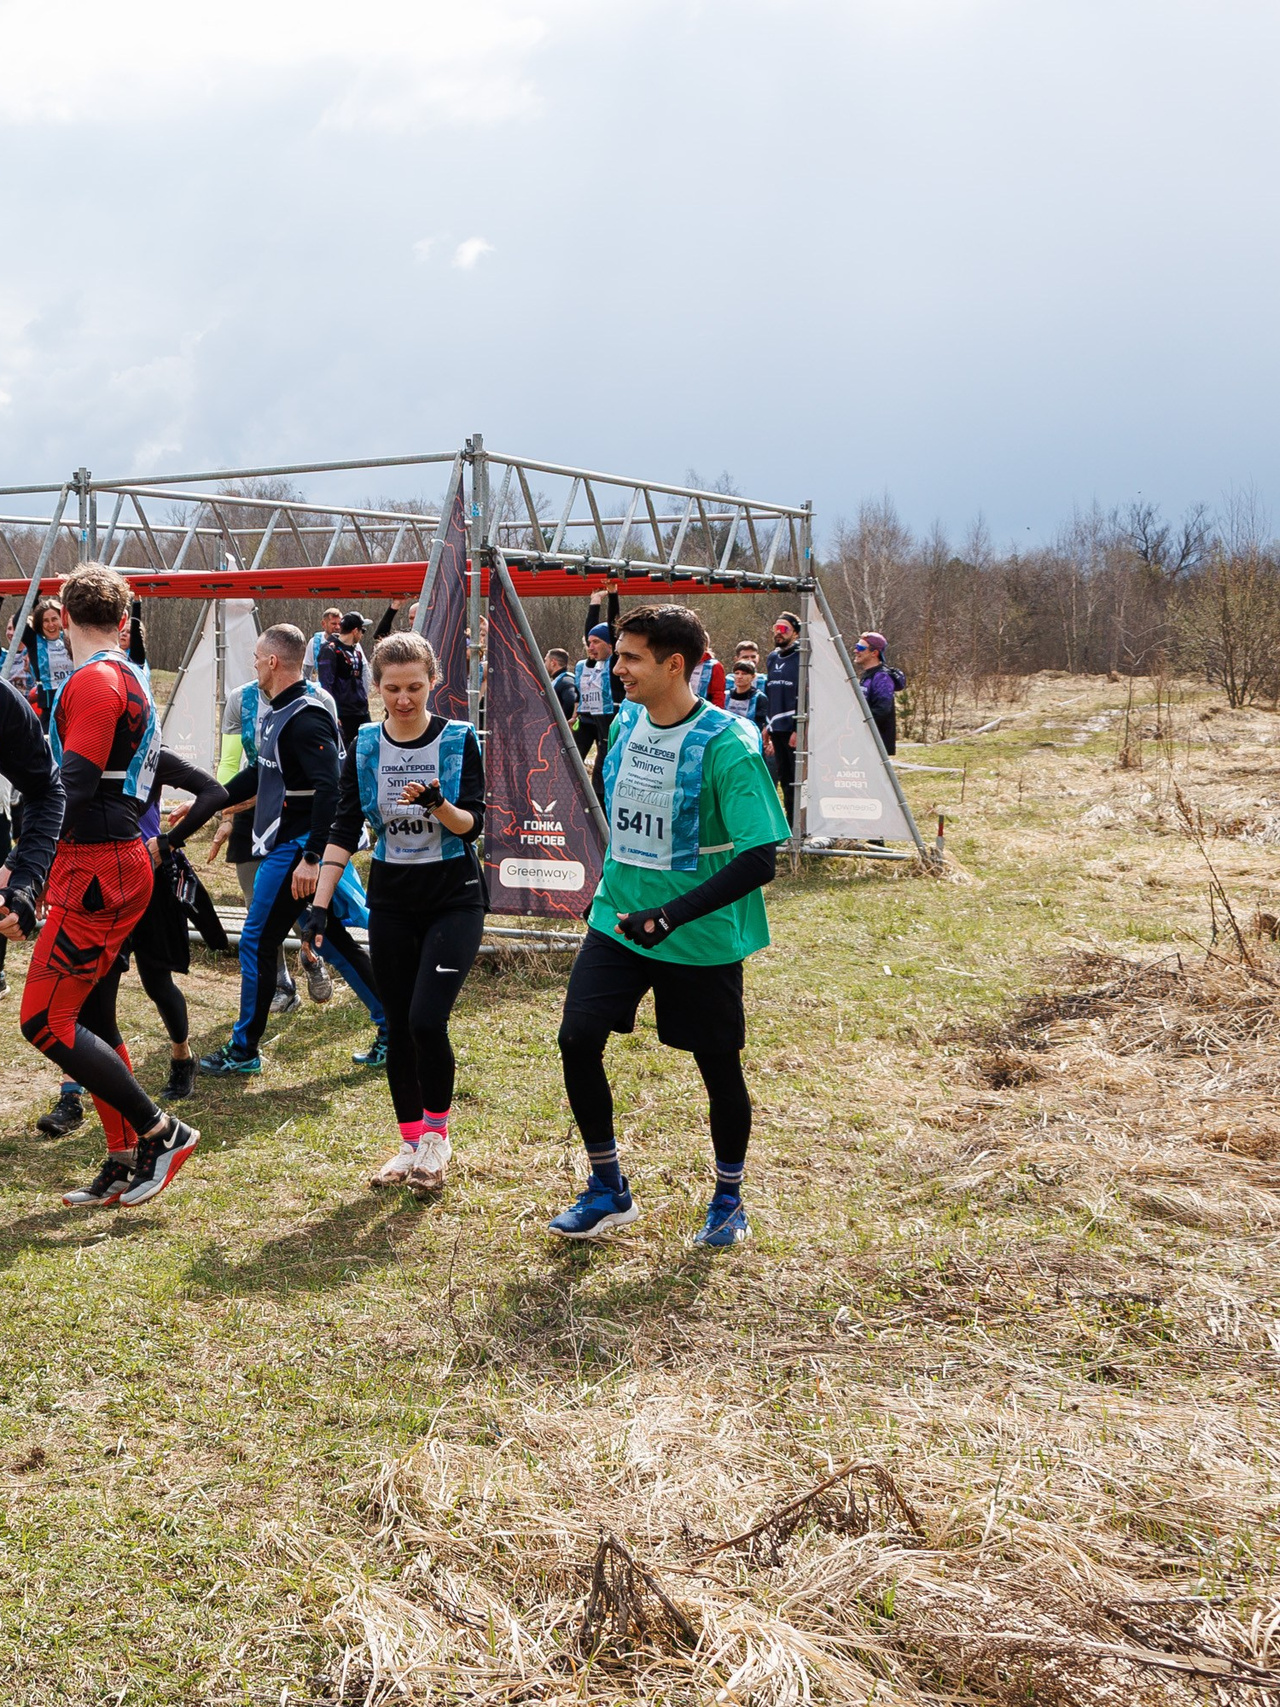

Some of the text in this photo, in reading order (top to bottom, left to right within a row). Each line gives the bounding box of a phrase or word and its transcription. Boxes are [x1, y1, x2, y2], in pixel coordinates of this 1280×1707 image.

[628, 742, 676, 760] ГОНКА ГЕРОЕВ
[405, 764, 436, 772] ГЕРОЕВ
[631, 756, 665, 776] Sminex
[523, 820, 564, 832] ГОНКА
[616, 807, 664, 840] 5411
[520, 834, 566, 847] ГЕРОЕВ
[506, 864, 569, 881] Greenway
